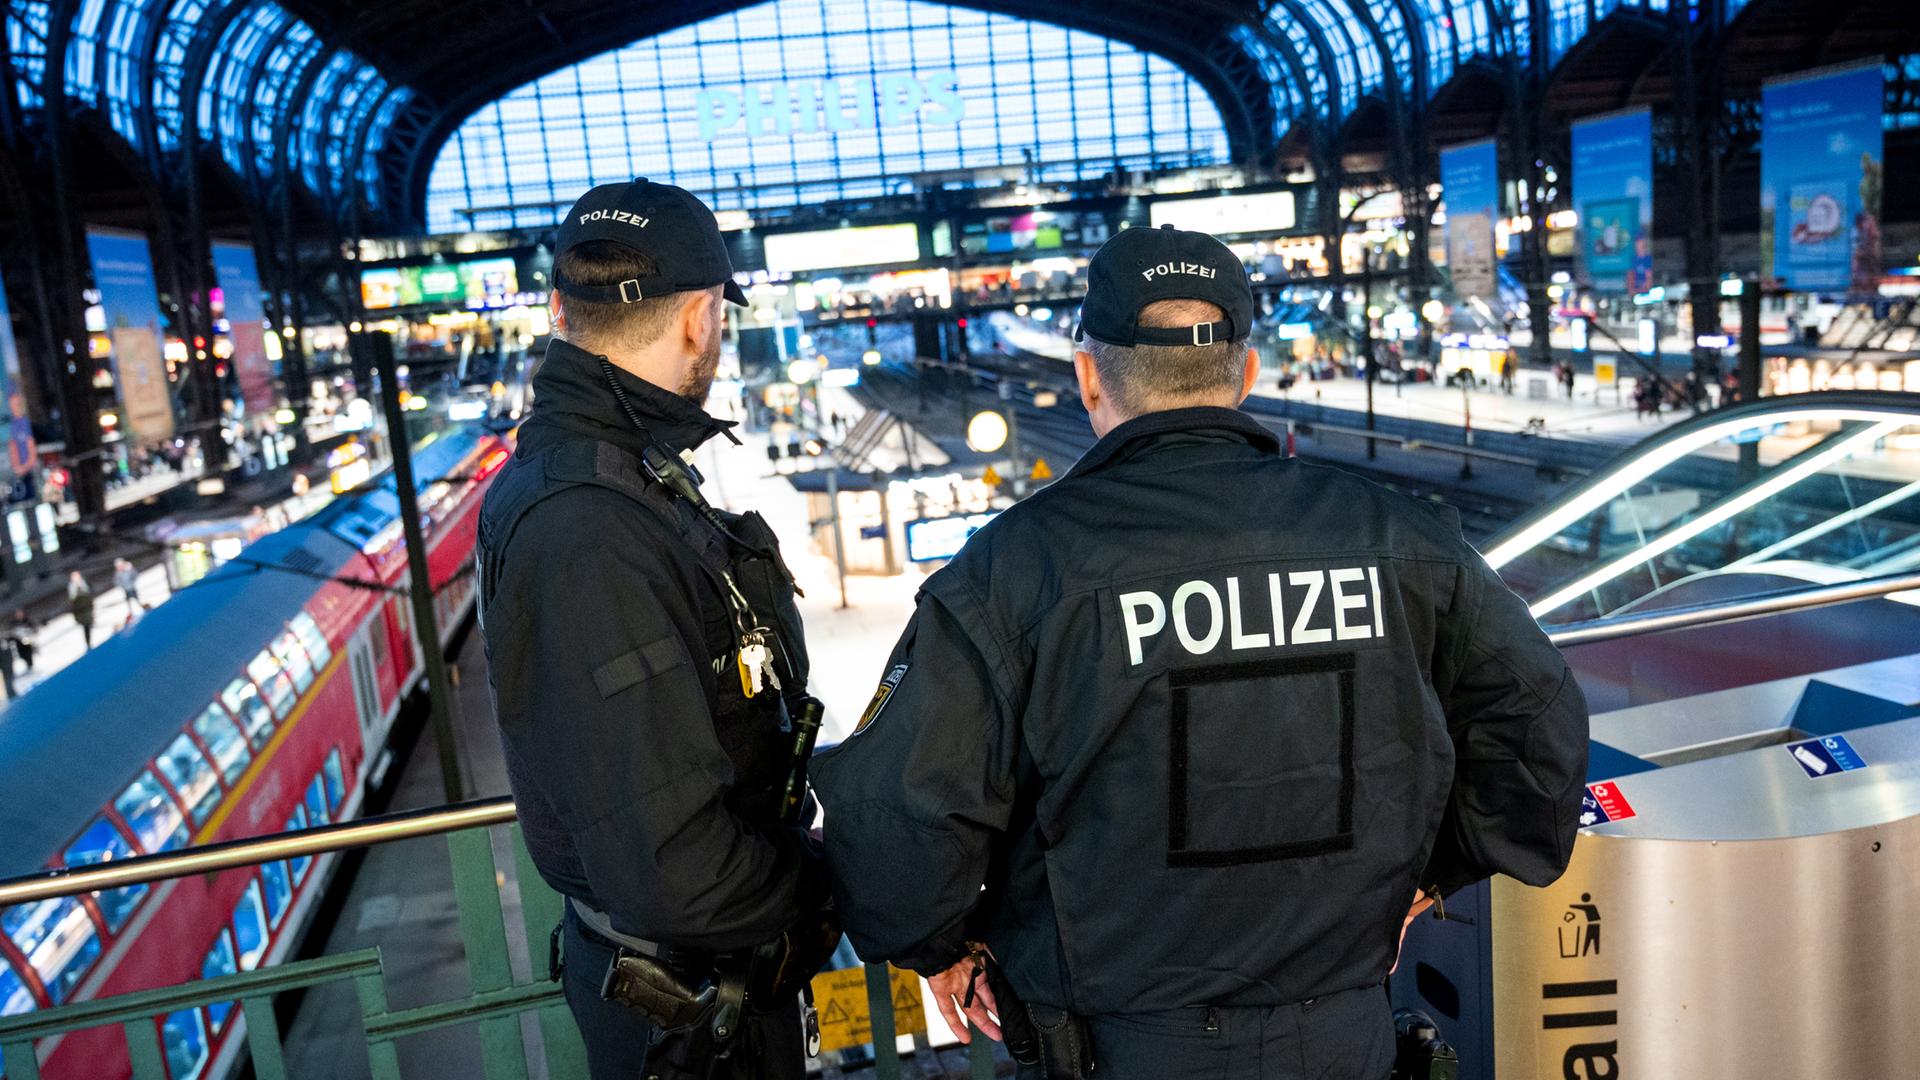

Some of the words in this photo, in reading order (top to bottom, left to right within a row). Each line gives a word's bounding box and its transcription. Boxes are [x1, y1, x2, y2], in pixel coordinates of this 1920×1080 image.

[695, 70, 966, 142] PHILIPS
[579, 209, 649, 228] POLIZEI
[1142, 261, 1216, 281] POLIZEI
[1119, 566, 1384, 666] POLIZEI
